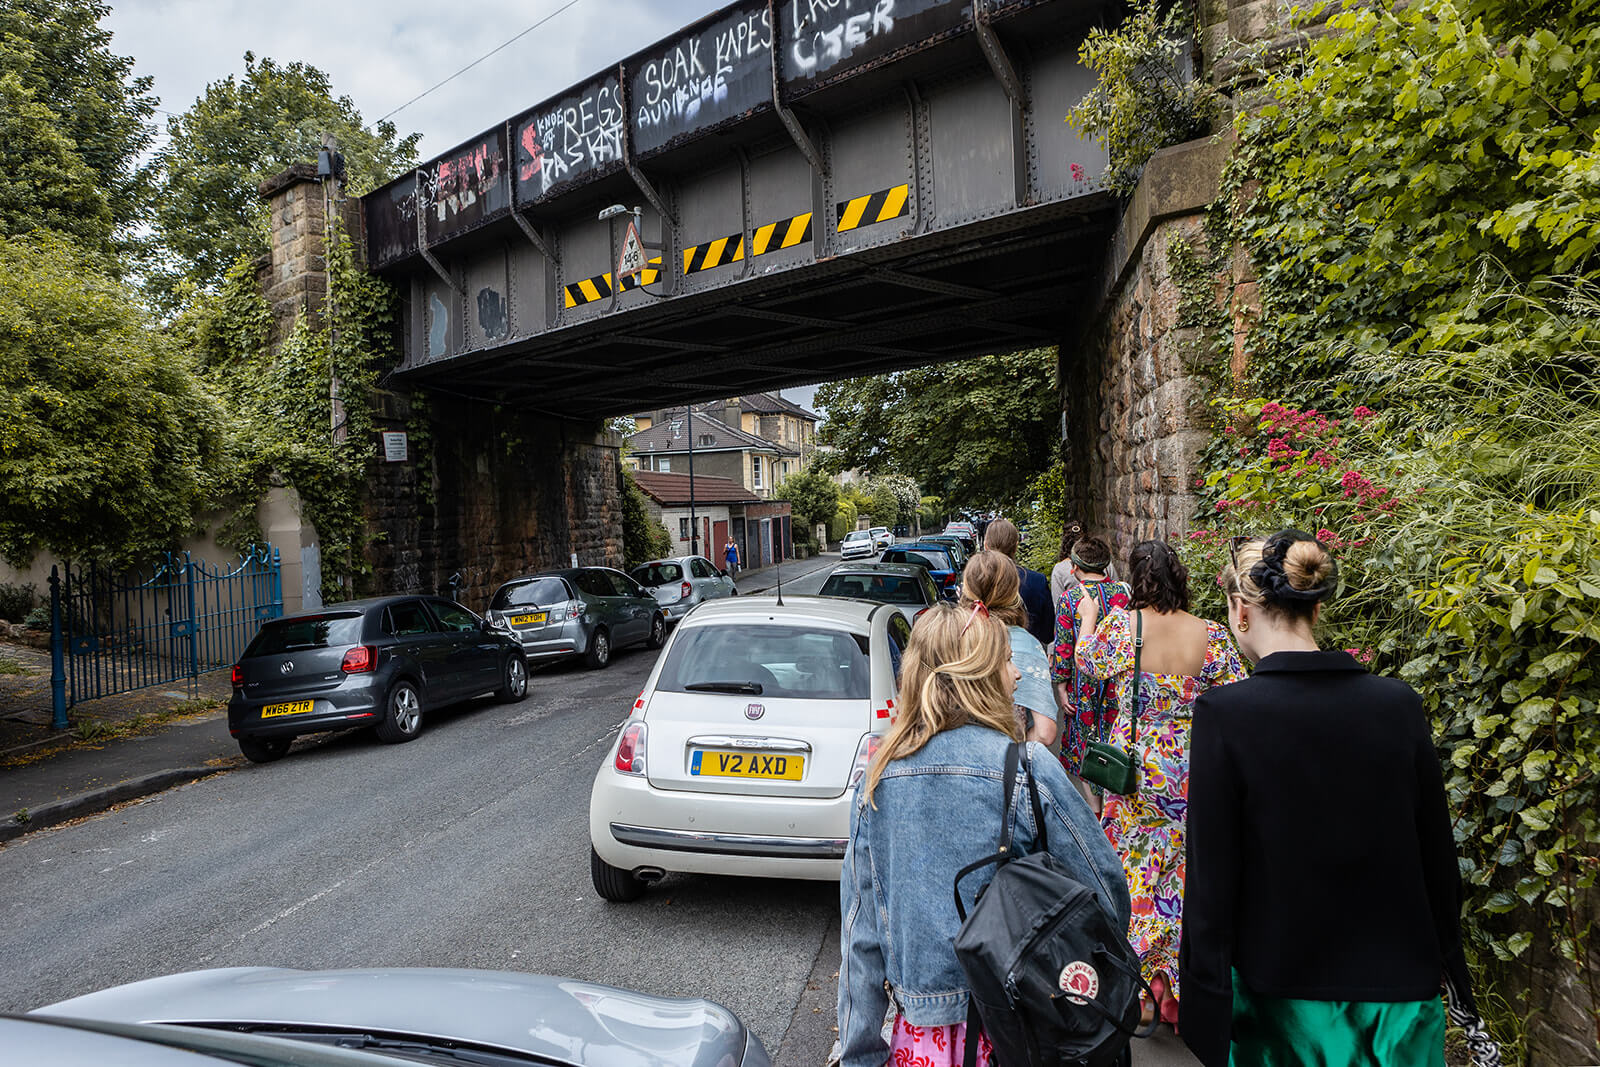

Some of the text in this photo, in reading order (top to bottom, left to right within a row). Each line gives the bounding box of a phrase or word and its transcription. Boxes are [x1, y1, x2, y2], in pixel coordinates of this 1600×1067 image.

[646, 38, 704, 105] SOAK
[265, 701, 310, 716] MW66 ZTR
[719, 754, 787, 775] V2 AXD
